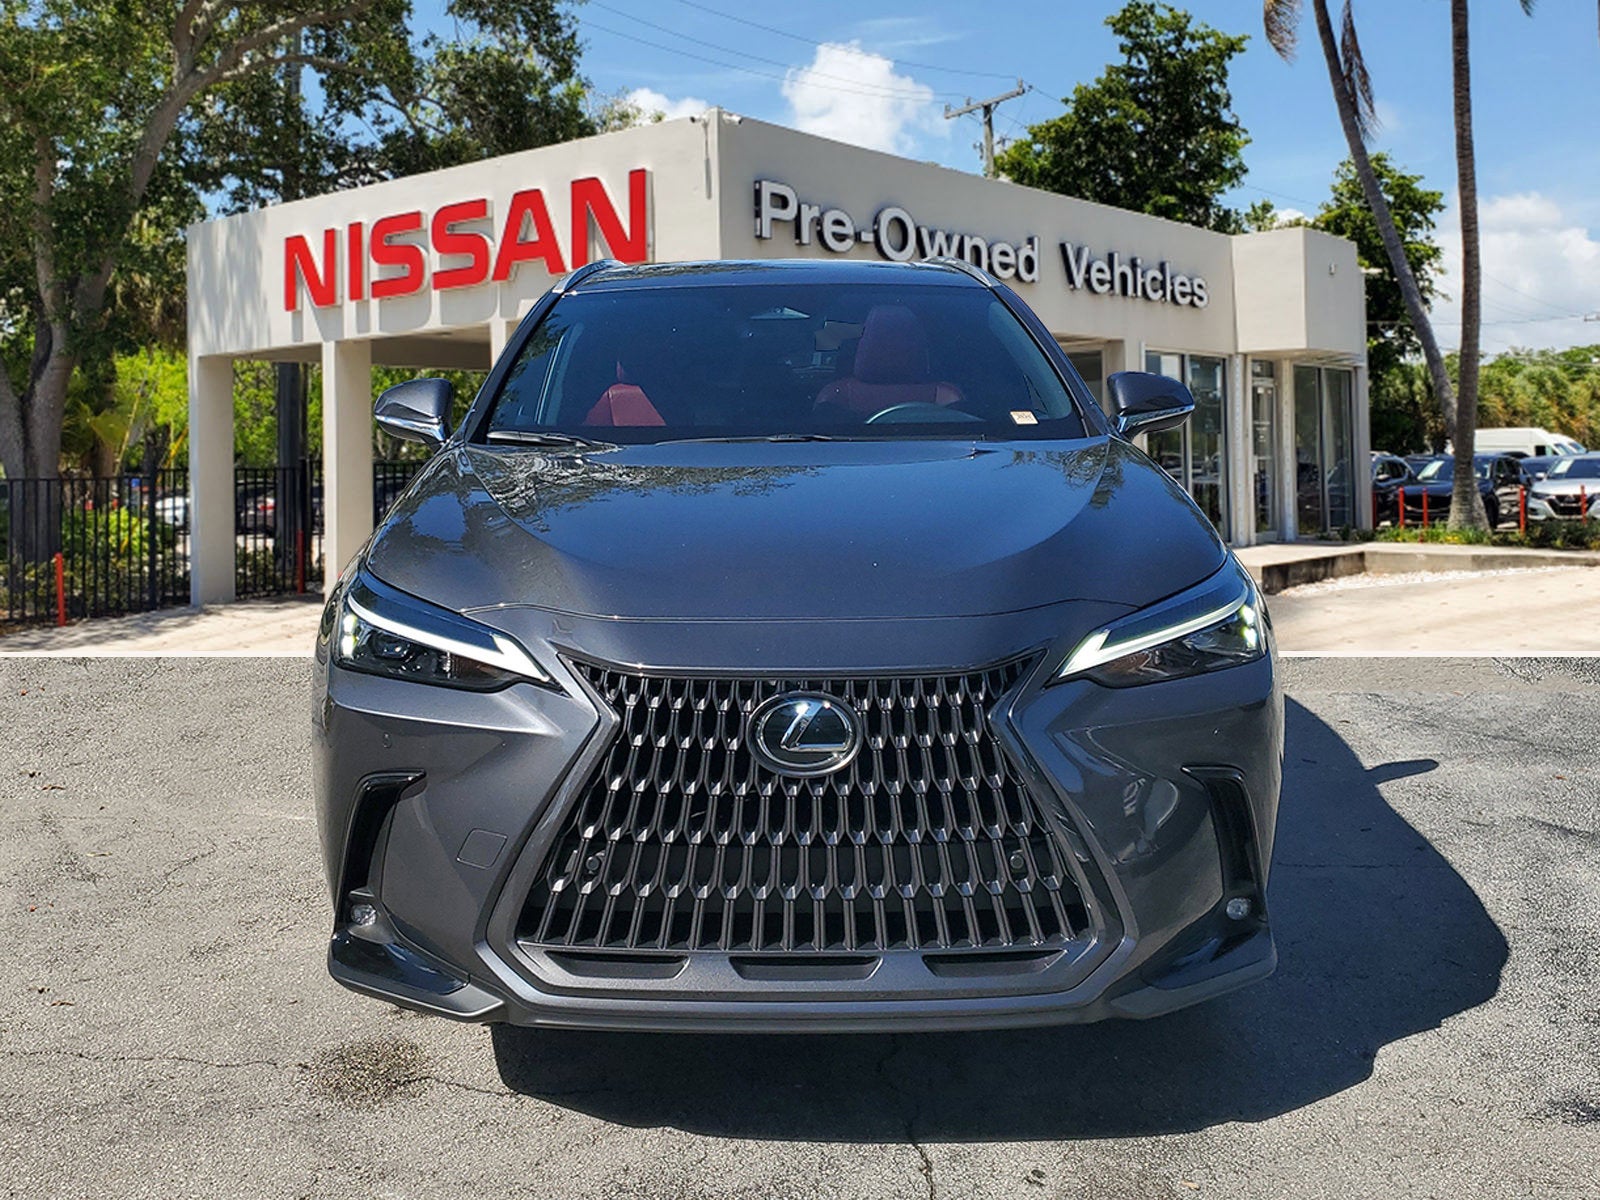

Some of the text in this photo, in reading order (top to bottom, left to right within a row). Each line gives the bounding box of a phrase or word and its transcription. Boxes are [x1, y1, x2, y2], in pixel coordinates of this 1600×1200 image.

[285, 168, 646, 311] NISSAN
[756, 180, 1209, 308] Pre-Owned Vehicles
